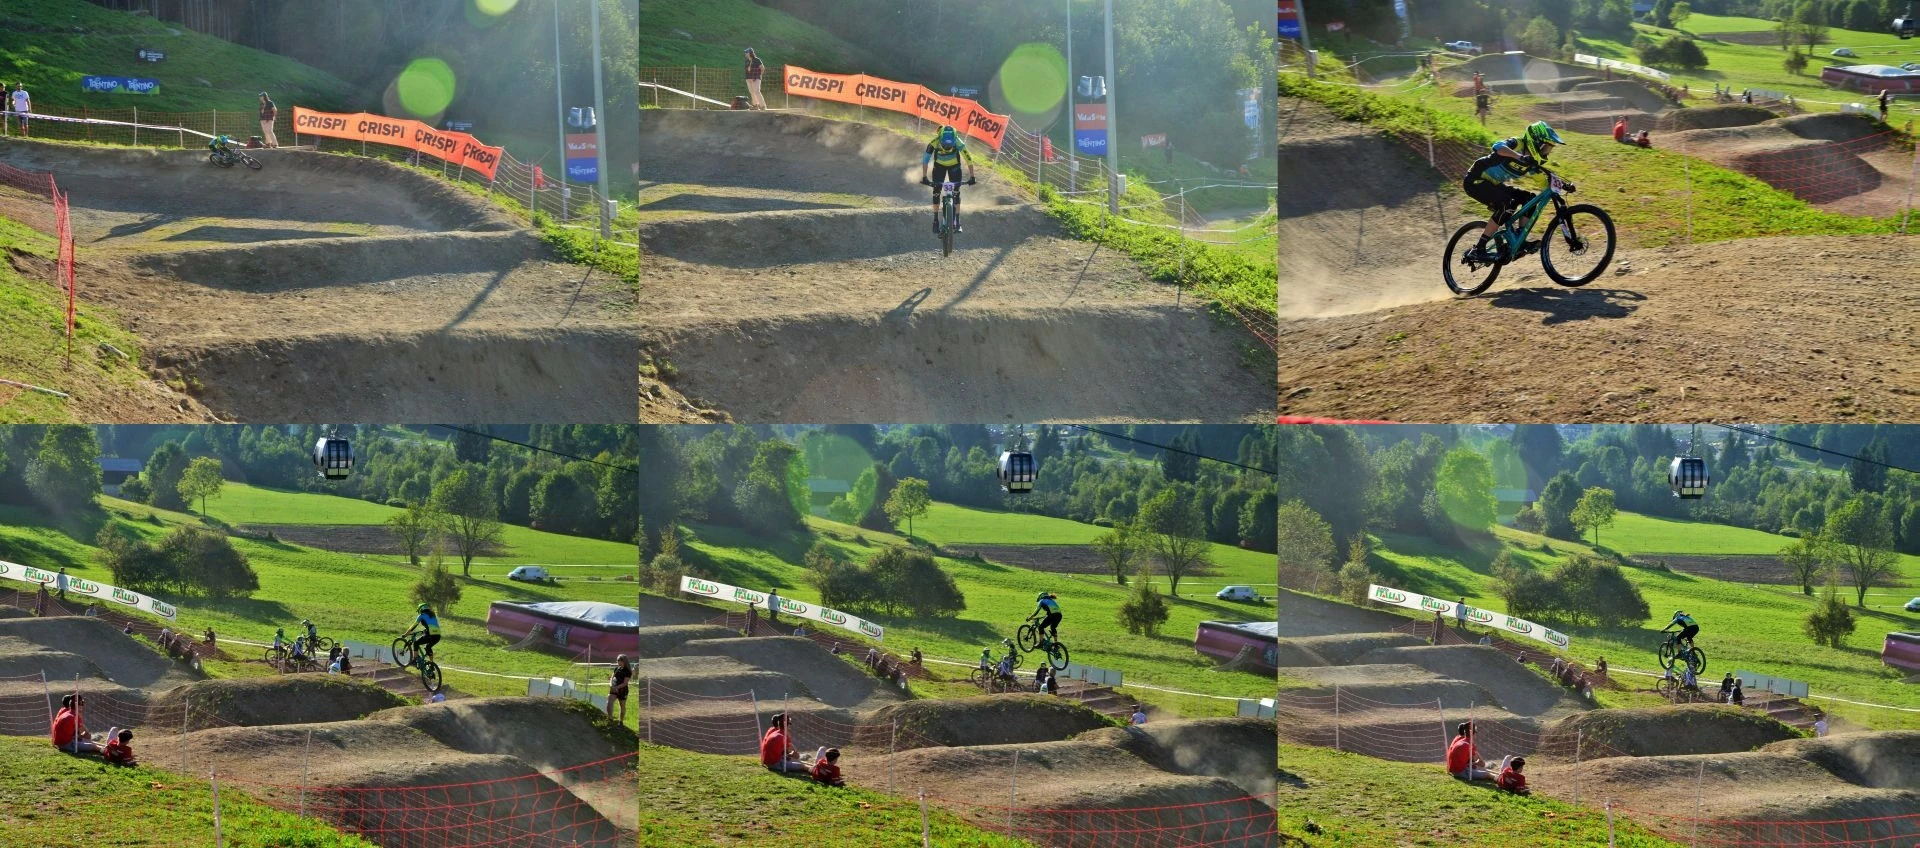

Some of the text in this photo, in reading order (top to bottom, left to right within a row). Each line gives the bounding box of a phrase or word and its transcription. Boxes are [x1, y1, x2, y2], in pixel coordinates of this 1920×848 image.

[88, 77, 153, 91] TRENTINO TRENTINO
[788, 74, 1002, 138] CRISPI CRISPI CRISPI CRISPI
[297, 114, 496, 168] CRISPI CRISPI CRISPI CRISPI
[70, 579, 94, 591] ITALIA
[112, 589, 136, 602] ITALIA
[688, 580, 714, 593] ITALIA
[733, 590, 758, 602] ITALIA
[820, 610, 843, 623] ITALIA
[1375, 589, 1400, 601] ITALIA
[1421, 598, 1445, 611] ITALIA
[1506, 618, 1528, 632] ITALIA
